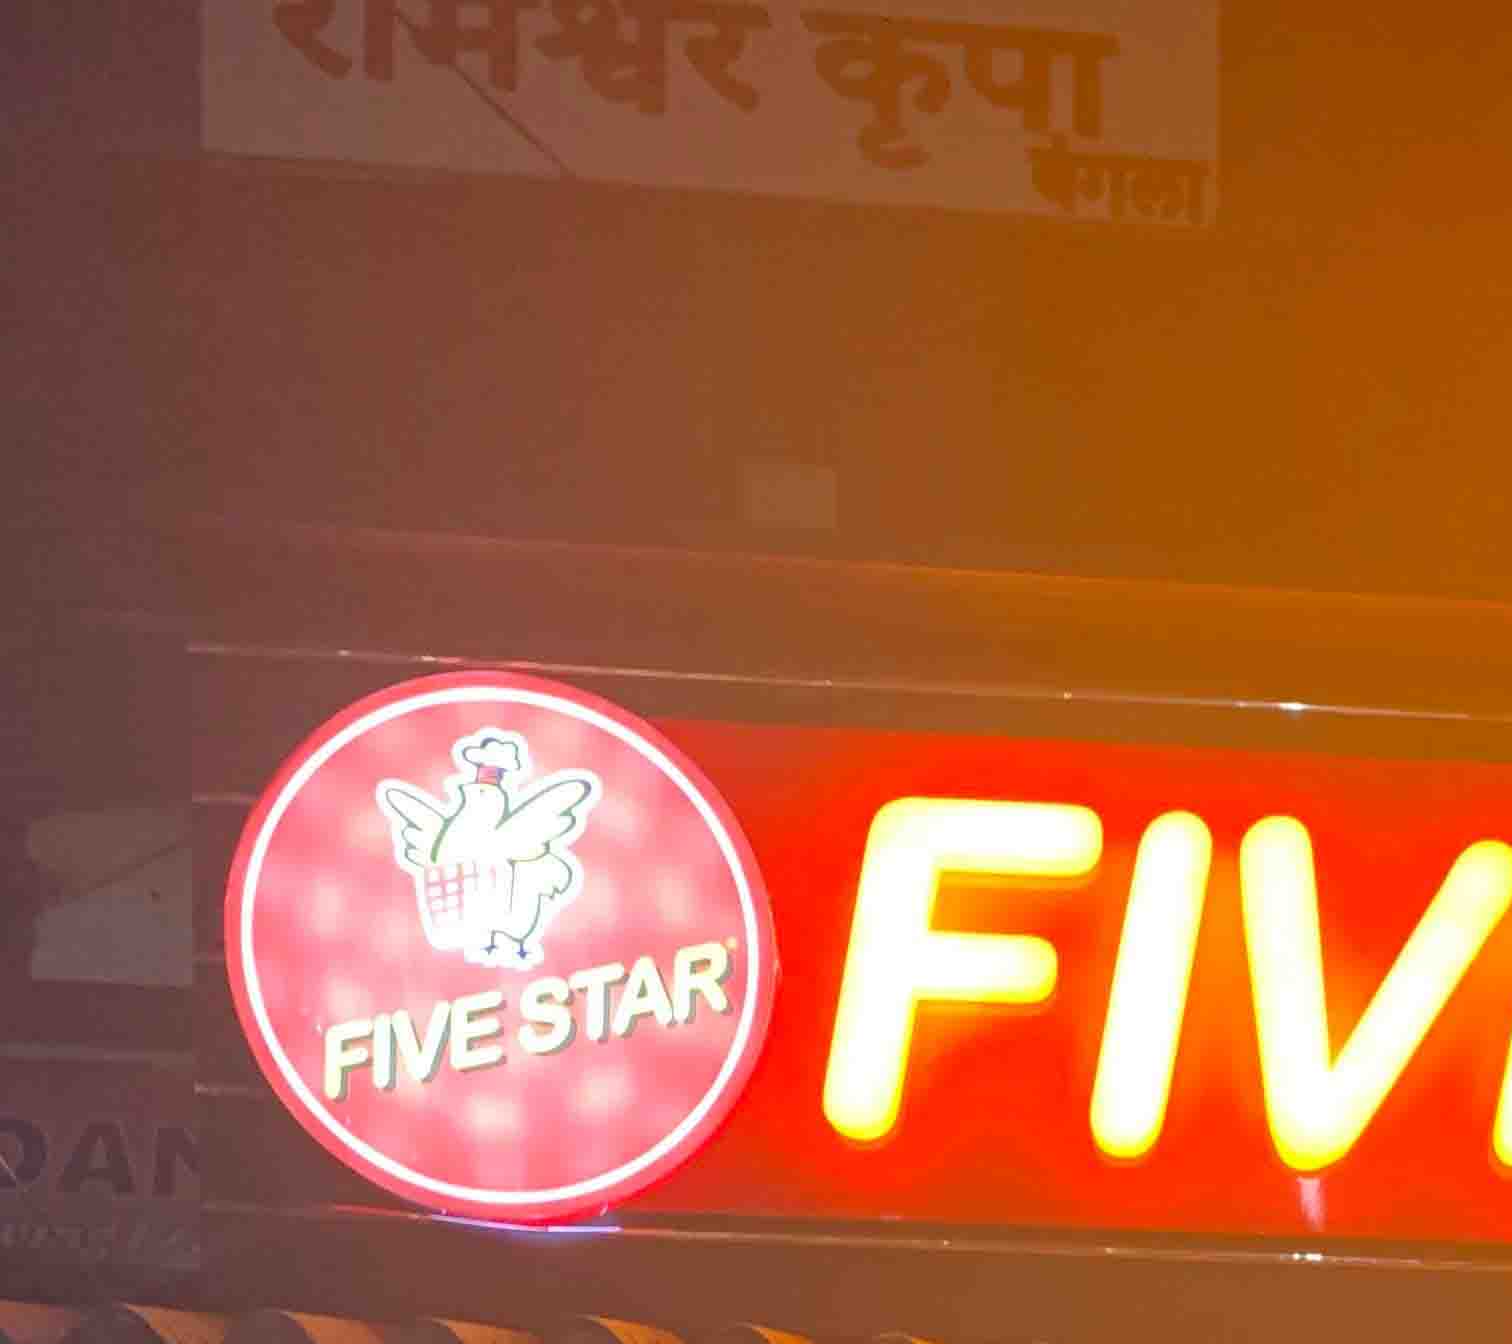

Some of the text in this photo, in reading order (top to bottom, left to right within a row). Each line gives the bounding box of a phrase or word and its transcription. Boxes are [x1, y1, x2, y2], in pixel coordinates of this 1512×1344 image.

[802, 8, 1122, 170] कृपा
[323, 942, 732, 1101] FIVE STAR
